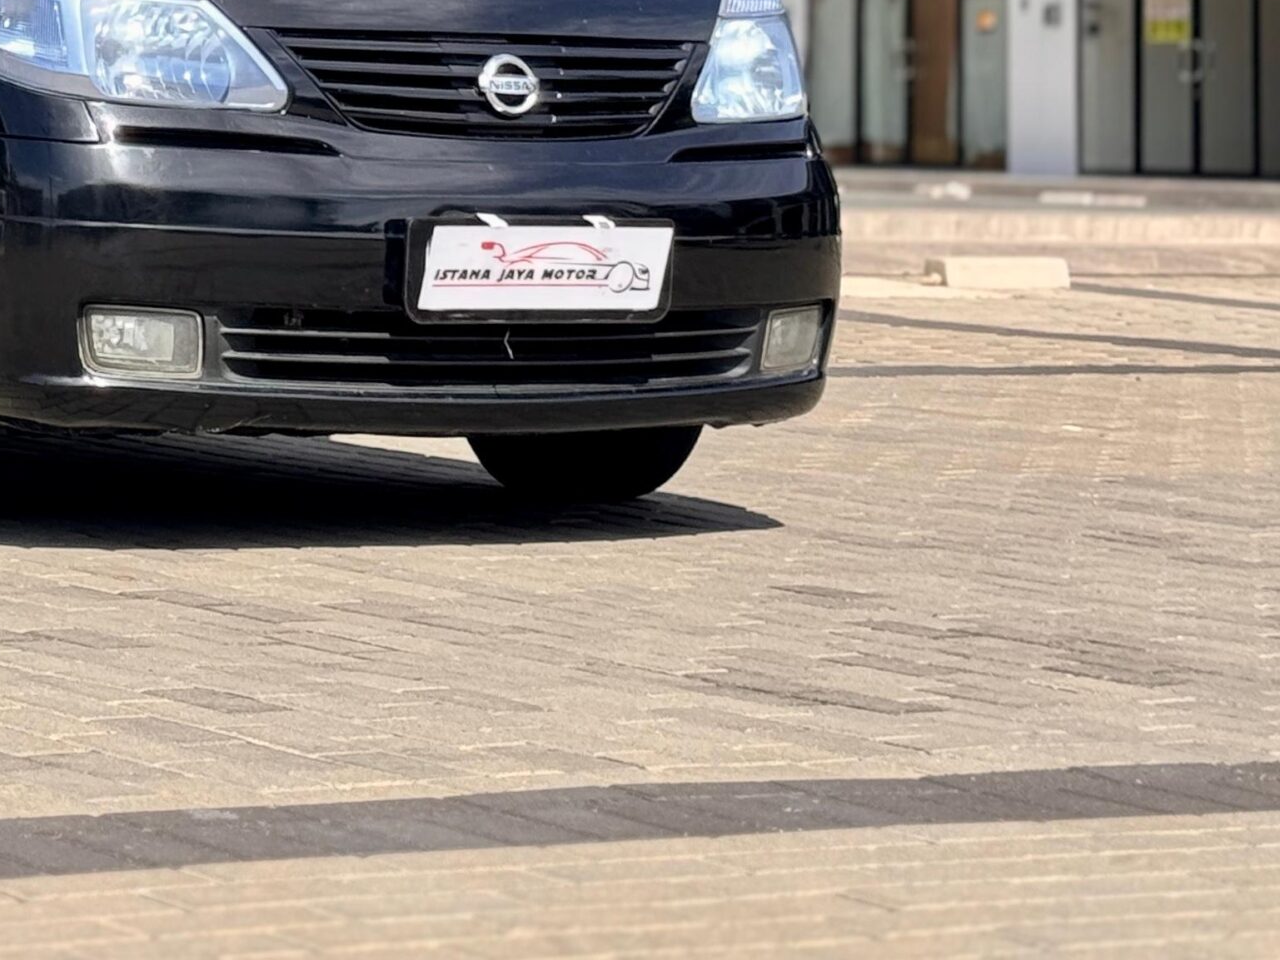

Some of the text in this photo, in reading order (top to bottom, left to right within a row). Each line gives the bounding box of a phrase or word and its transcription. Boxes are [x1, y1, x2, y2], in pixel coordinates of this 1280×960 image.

[434, 268, 597, 283] ISTANA JAYA MOTOR
